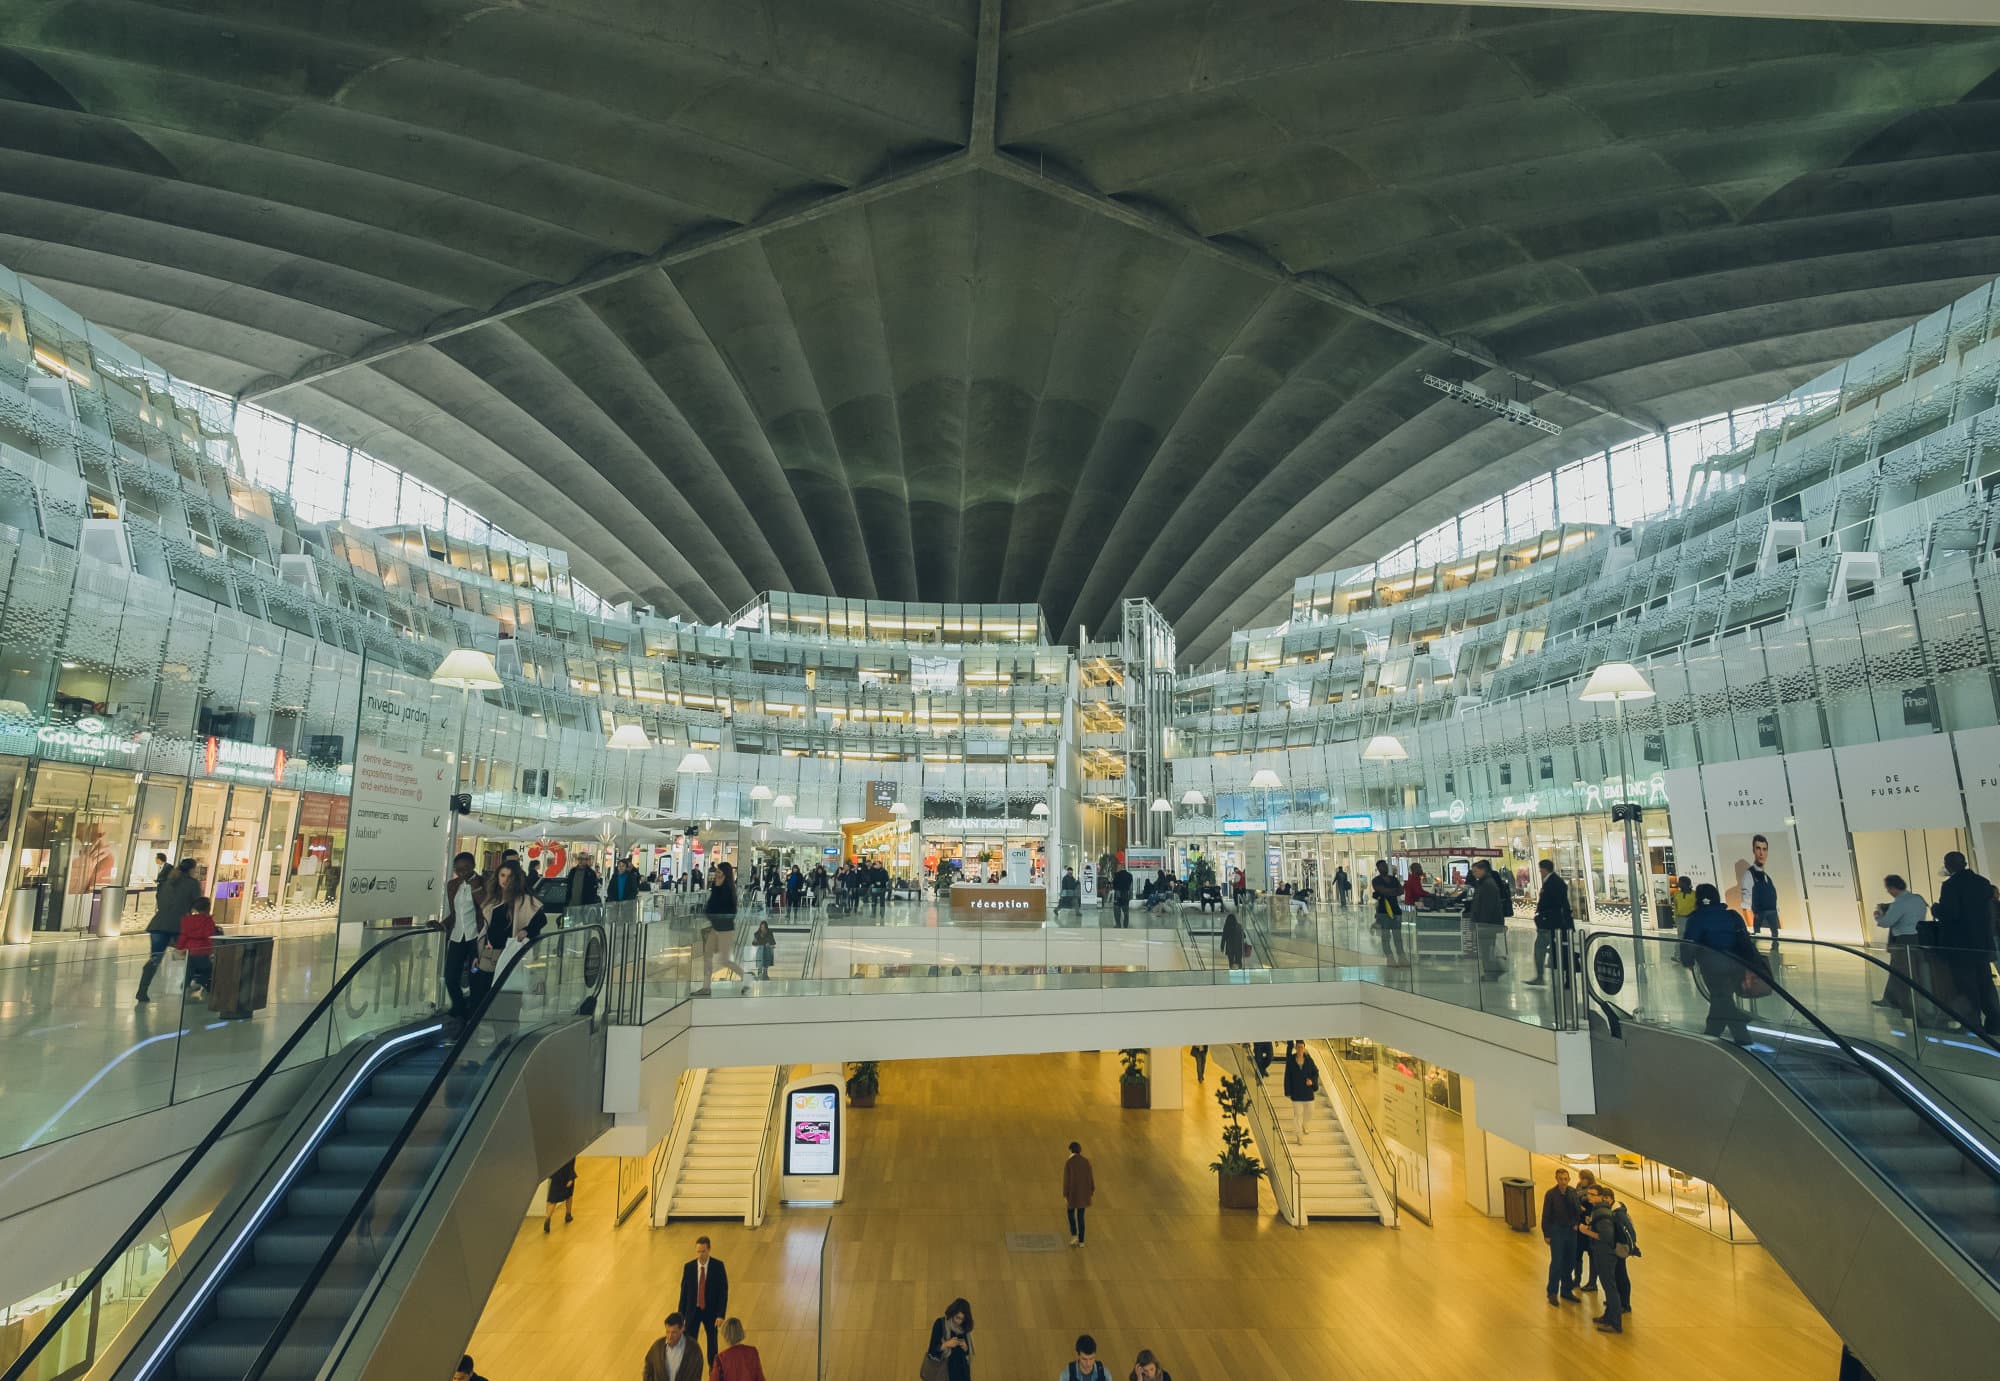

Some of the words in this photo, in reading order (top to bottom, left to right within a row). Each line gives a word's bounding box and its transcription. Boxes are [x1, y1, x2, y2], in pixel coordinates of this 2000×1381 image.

[368, 696, 400, 716] niveau
[401, 706, 429, 723] jardin
[1886, 774, 1900, 783] DE
[1738, 789, 1749, 797] DE
[1871, 785, 1920, 796] FURSAC
[1728, 798, 1764, 807] FURSAC
[358, 809, 389, 820] commerces
[948, 818, 978, 829] ALAIN
[970, 899, 1029, 910] réception
